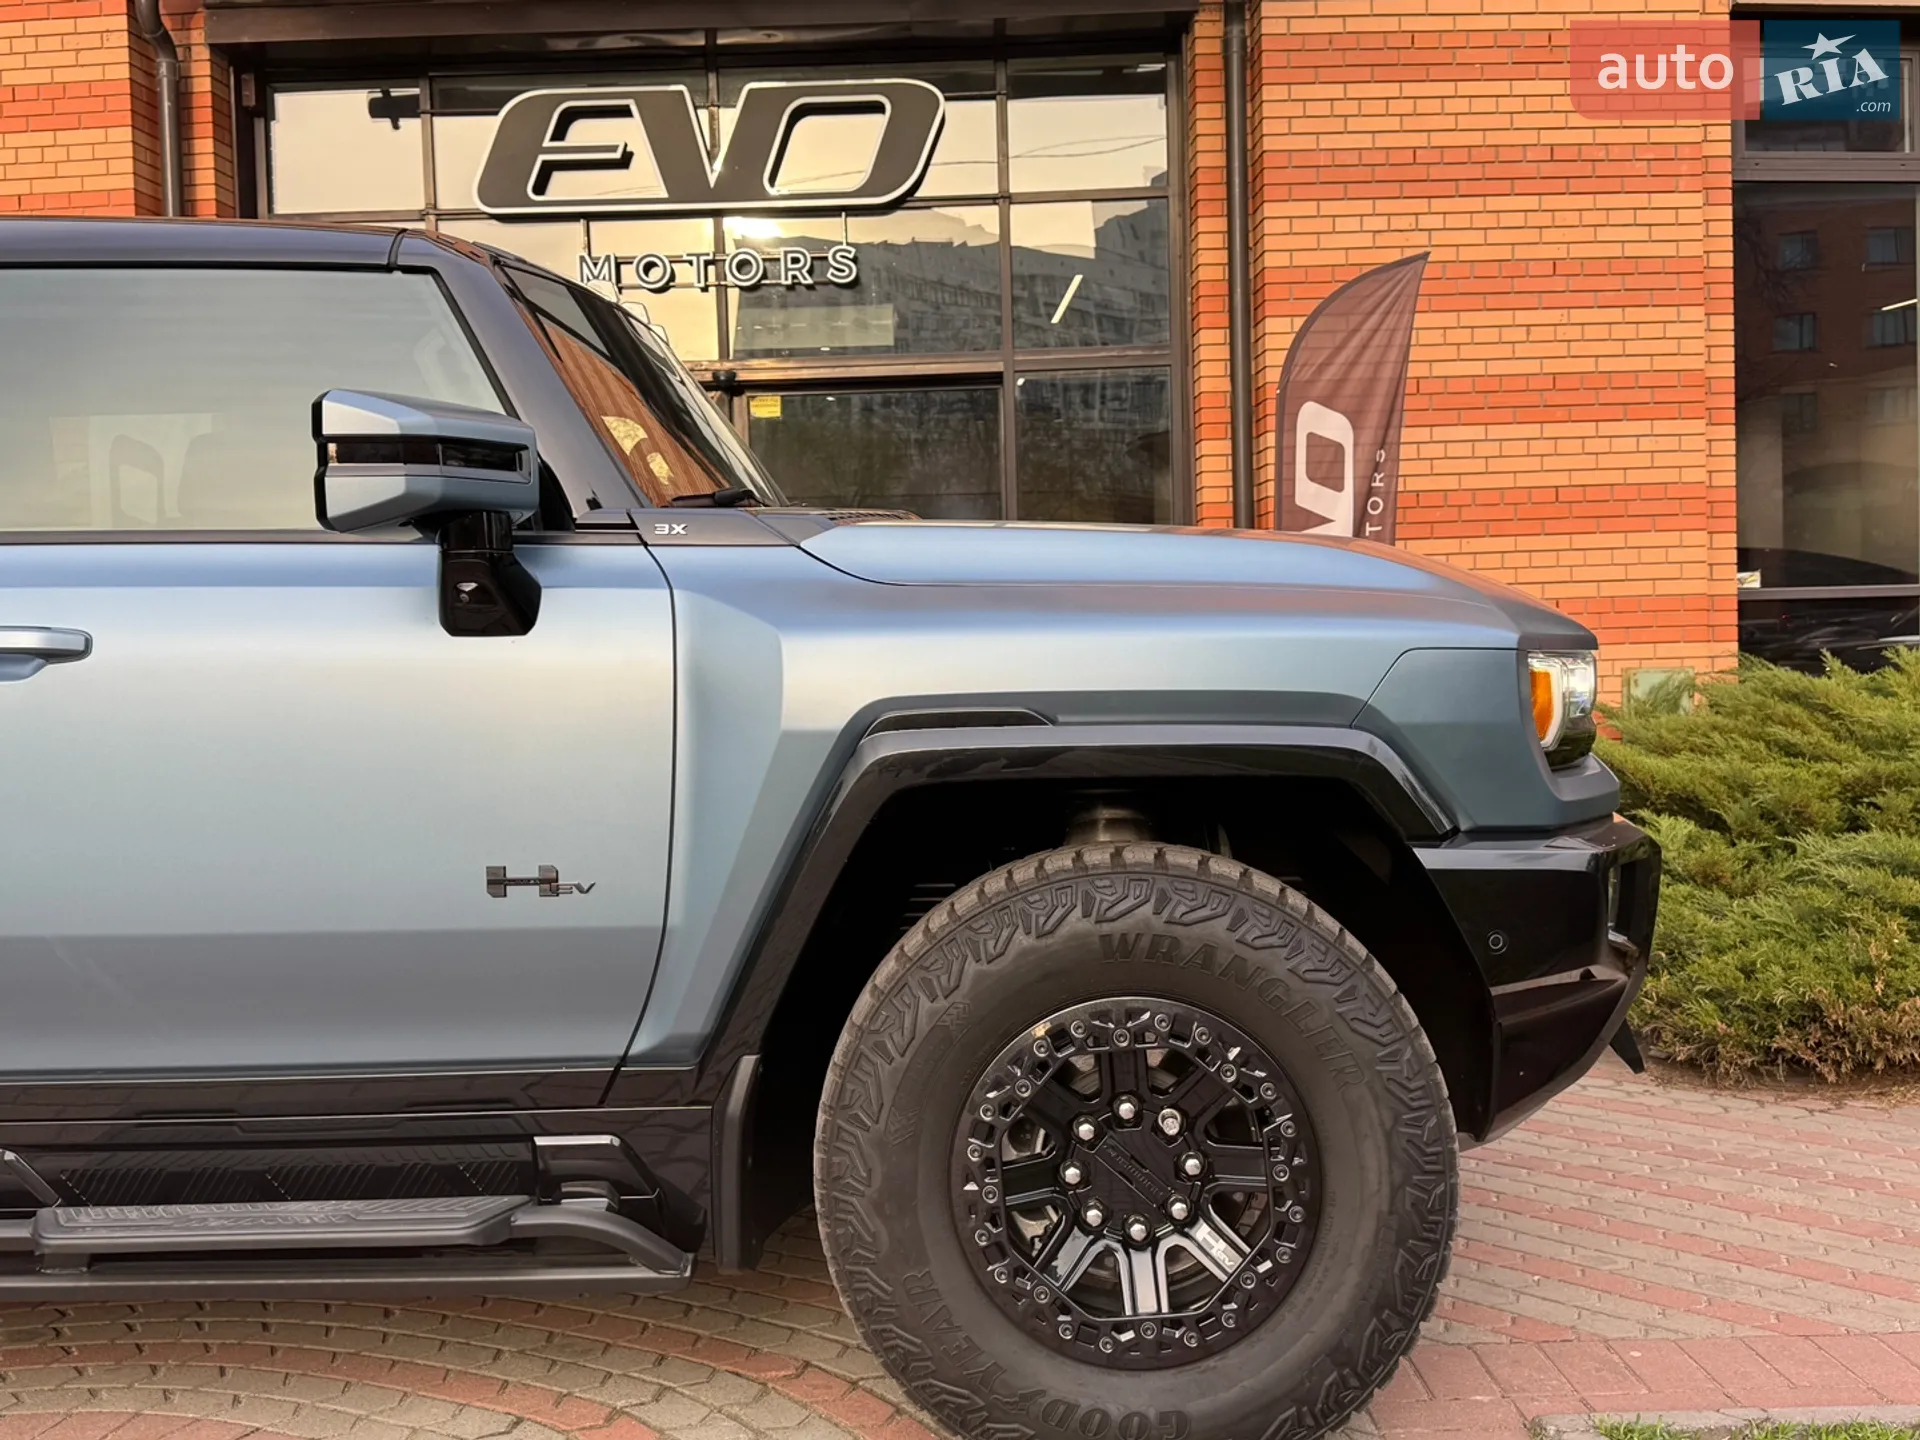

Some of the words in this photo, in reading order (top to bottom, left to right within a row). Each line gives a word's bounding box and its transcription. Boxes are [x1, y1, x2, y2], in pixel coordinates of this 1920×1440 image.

[472, 78, 945, 214] EVO
[576, 245, 858, 290] MOTORS
[654, 523, 688, 535] 3X
[1100, 932, 1366, 1092] WRANGLER
